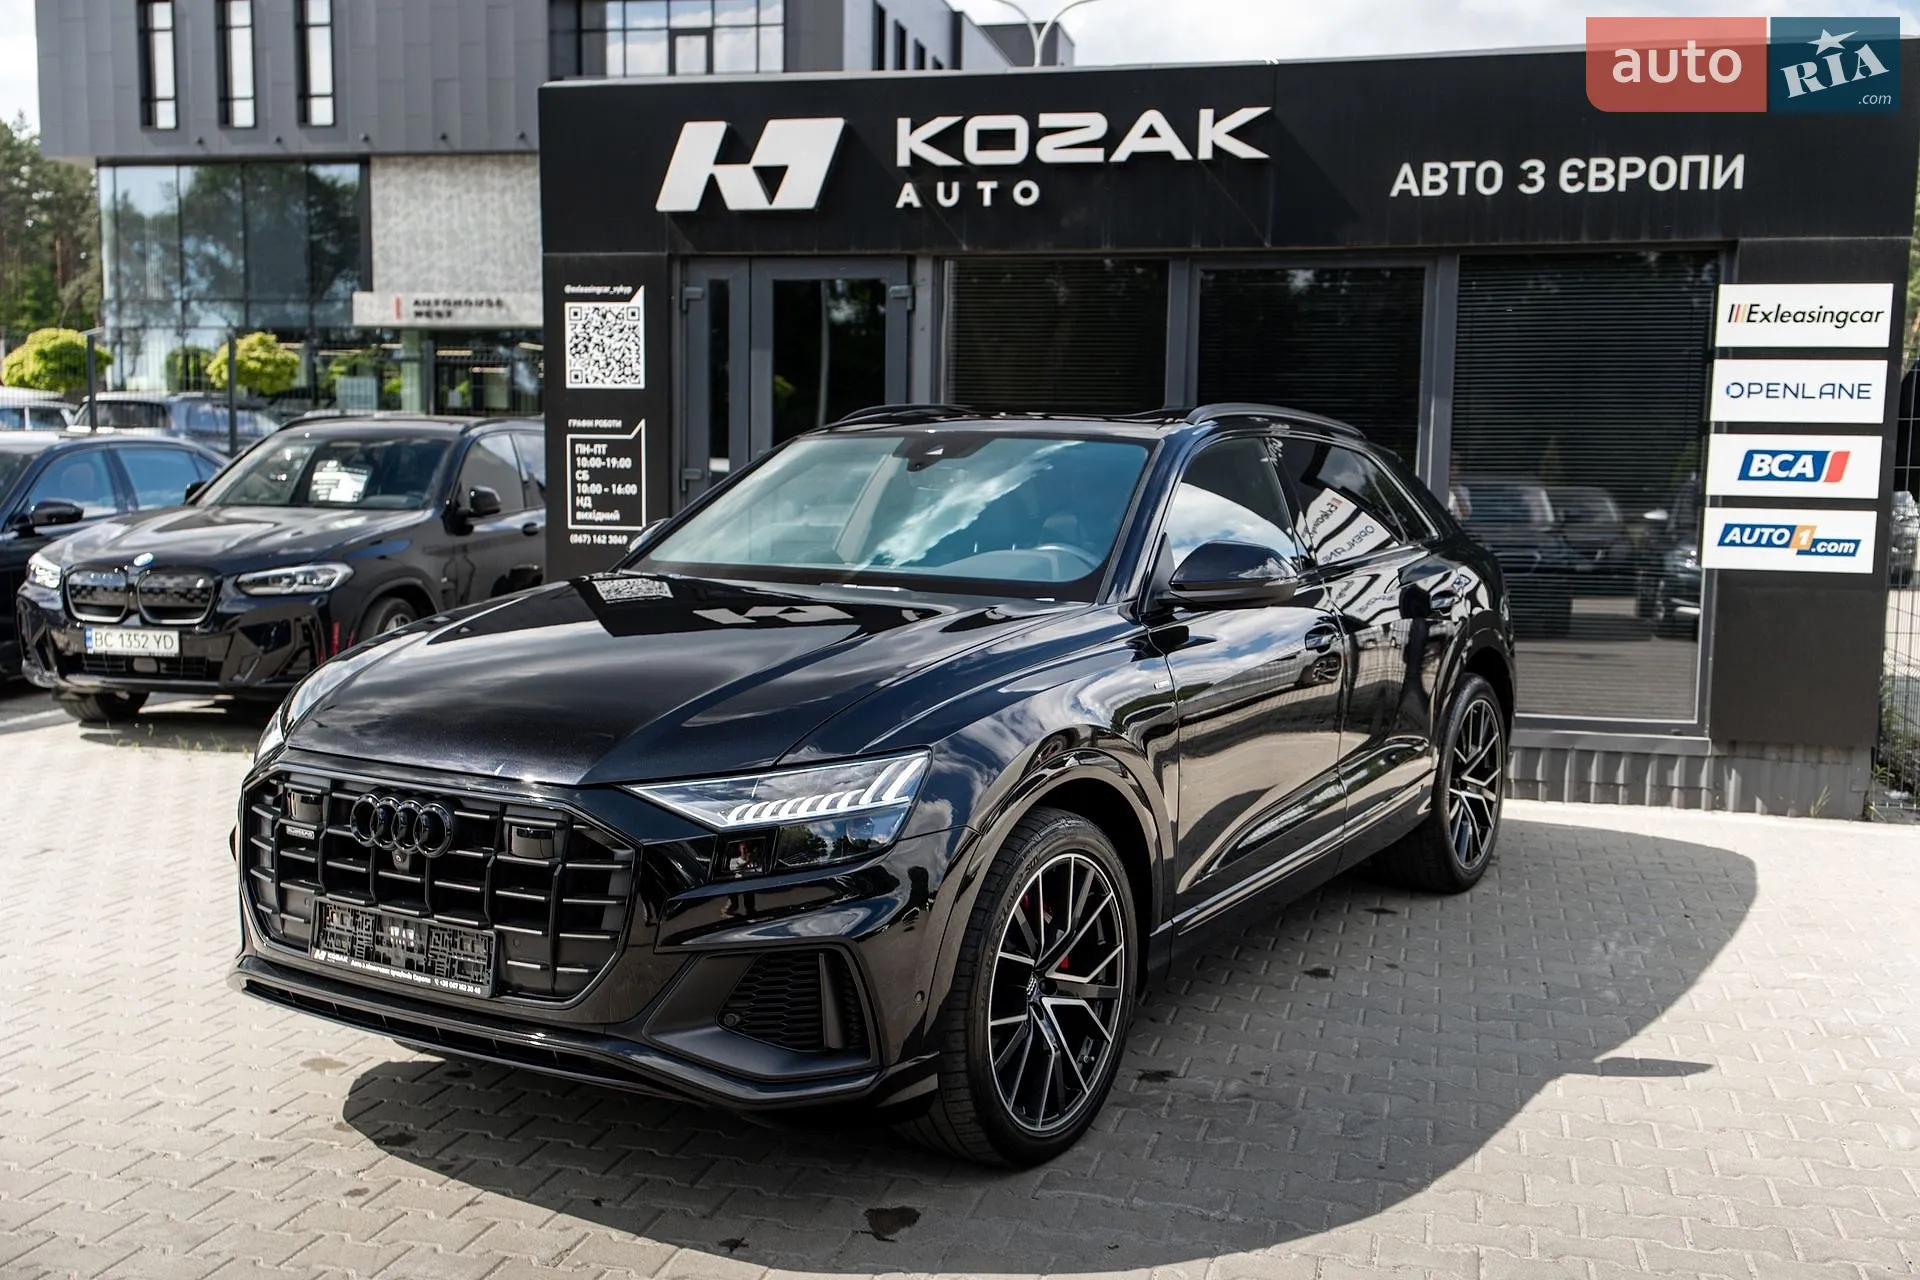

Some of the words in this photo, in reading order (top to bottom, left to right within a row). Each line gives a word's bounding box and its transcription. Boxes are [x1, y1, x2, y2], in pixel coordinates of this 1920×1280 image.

[896, 106, 1271, 167] KOZAK
[1390, 160, 1504, 197] АВТО
[1517, 158, 1546, 195] З
[1558, 154, 1745, 193] ЄВРОПИ
[896, 180, 1040, 209] AUTO
[1746, 303, 1885, 329] Exleasingcar
[1726, 382, 1873, 400] OPENLANE
[575, 443, 608, 455] ПН-ПТ
[576, 457, 632, 469] 10:00-19:00
[1748, 453, 1815, 478] BCA
[575, 469, 590, 481] СБ
[576, 483, 602, 495] 10:00
[611, 483, 638, 495] 16:00
[575, 496, 593, 508] НД
[94, 631, 113, 648] BC
[118, 633, 149, 649] 1352
[152, 634, 175, 650] YD
